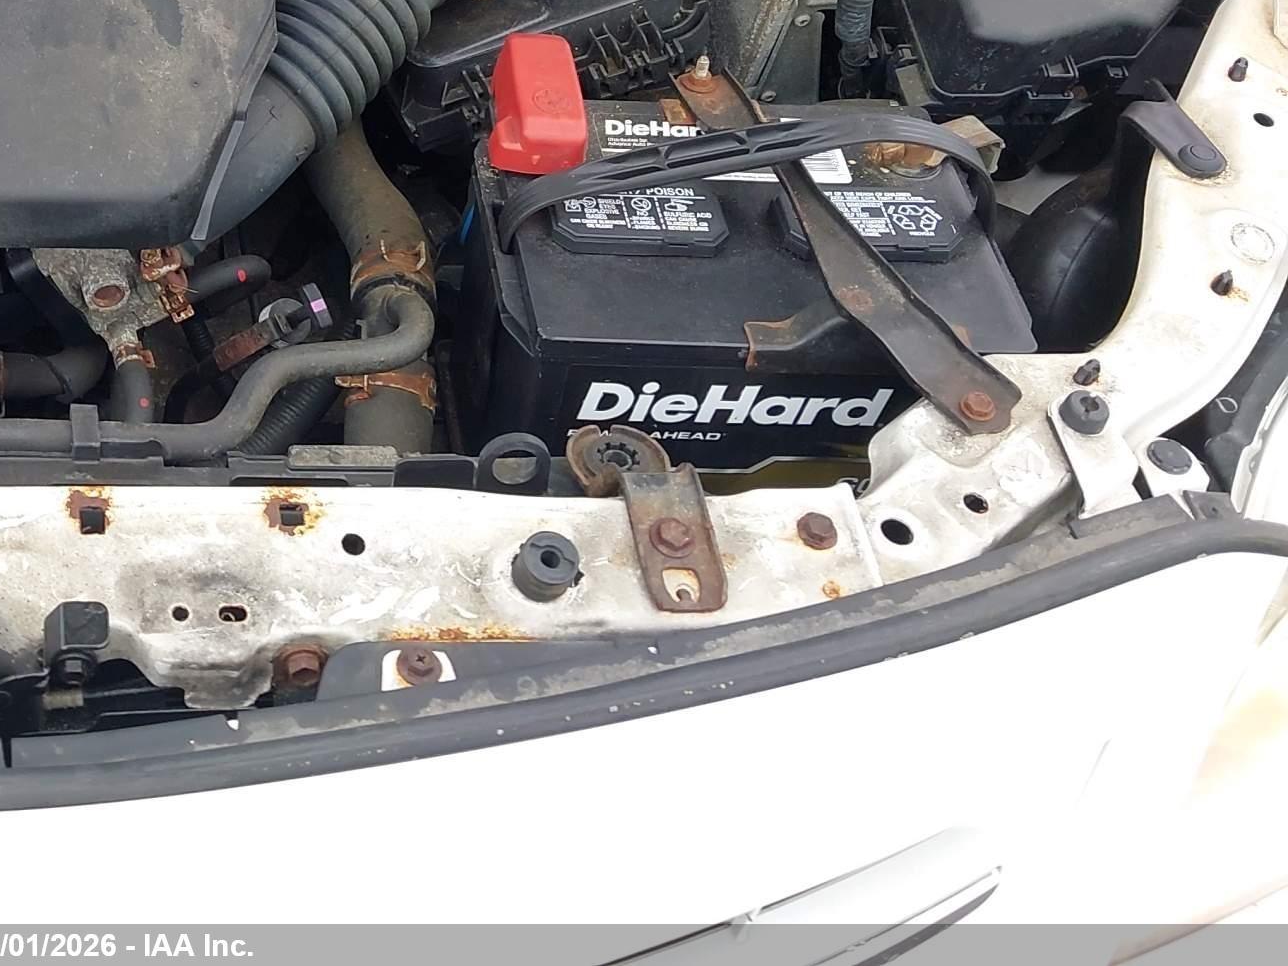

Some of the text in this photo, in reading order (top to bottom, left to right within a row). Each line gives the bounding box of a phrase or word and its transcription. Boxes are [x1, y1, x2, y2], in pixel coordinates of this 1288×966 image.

[605, 119, 706, 137] DieHar
[577, 381, 894, 427] DieHard
[650, 431, 721, 441] AHEAD
